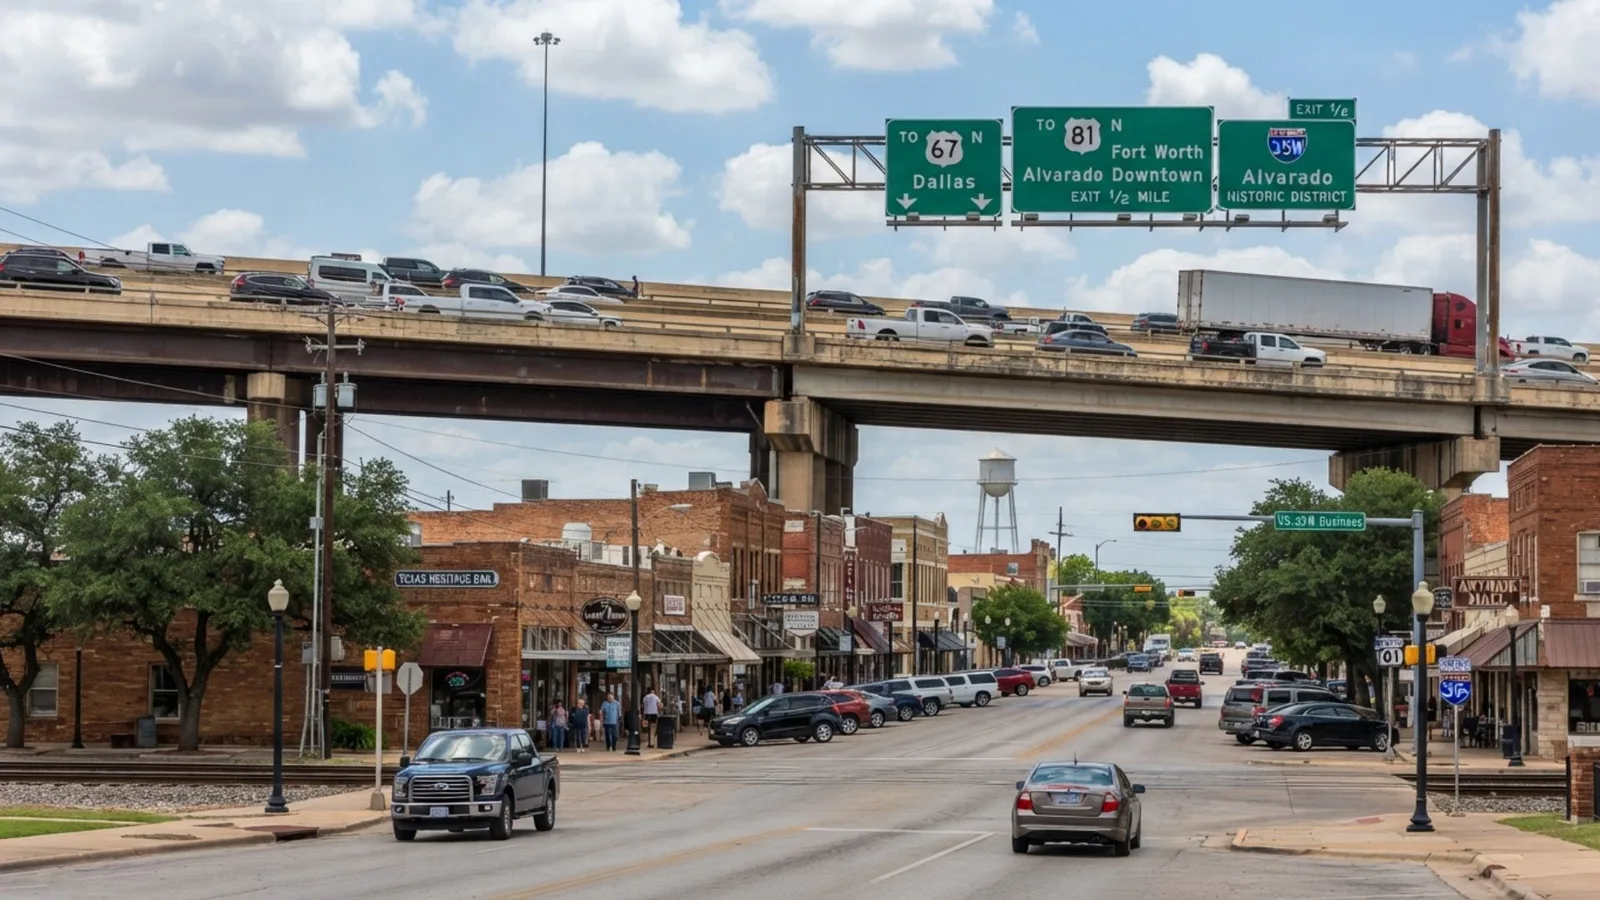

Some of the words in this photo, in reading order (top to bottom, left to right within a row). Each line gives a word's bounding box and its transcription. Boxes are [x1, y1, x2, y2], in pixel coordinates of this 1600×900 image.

[1036, 119, 1055, 131] TO
[1071, 126, 1093, 145] 81
[1111, 119, 1122, 132] N
[899, 131, 918, 143] TO
[931, 139, 958, 159] 67
[971, 131, 983, 144] N
[1111, 145, 1146, 159] Fort
[1154, 145, 1203, 159] Worth
[913, 174, 976, 189] Dallas
[1023, 167, 1103, 182] Alvarado
[1112, 167, 1203, 182] Downtown
[1242, 169, 1333, 185] Alvarado
[1071, 191, 1101, 203] EXIT
[1138, 191, 1170, 203] MILE
[1291, 190, 1348, 203] DISTRICT
